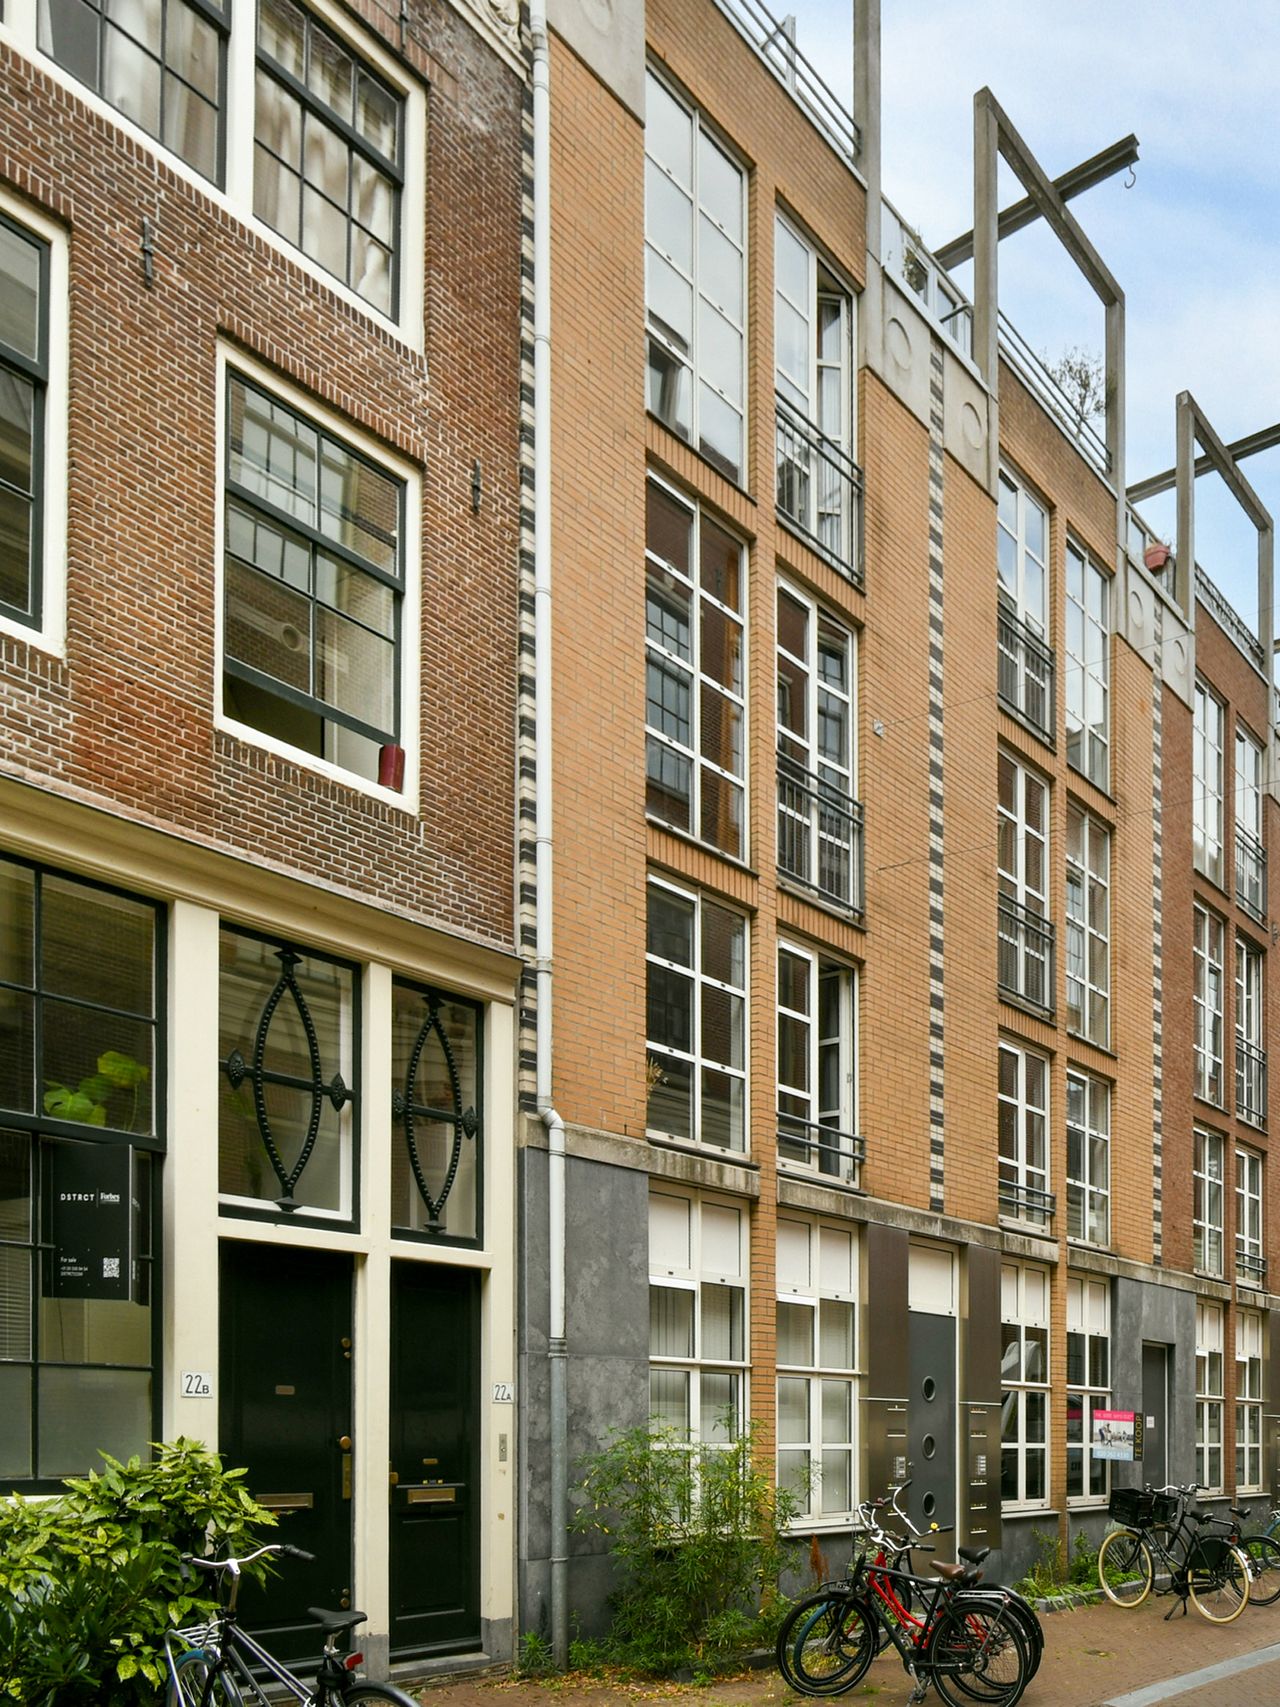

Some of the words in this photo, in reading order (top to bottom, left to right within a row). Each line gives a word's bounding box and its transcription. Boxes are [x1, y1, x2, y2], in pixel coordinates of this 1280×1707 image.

[60, 1193, 95, 1201] DSTRCT
[100, 1192, 120, 1201] Forbes
[185, 1374, 209, 1394] 22B
[495, 1384, 511, 1400] 22A
[1135, 1415, 1143, 1444] KOOP
[1135, 1446, 1142, 1458] TE
